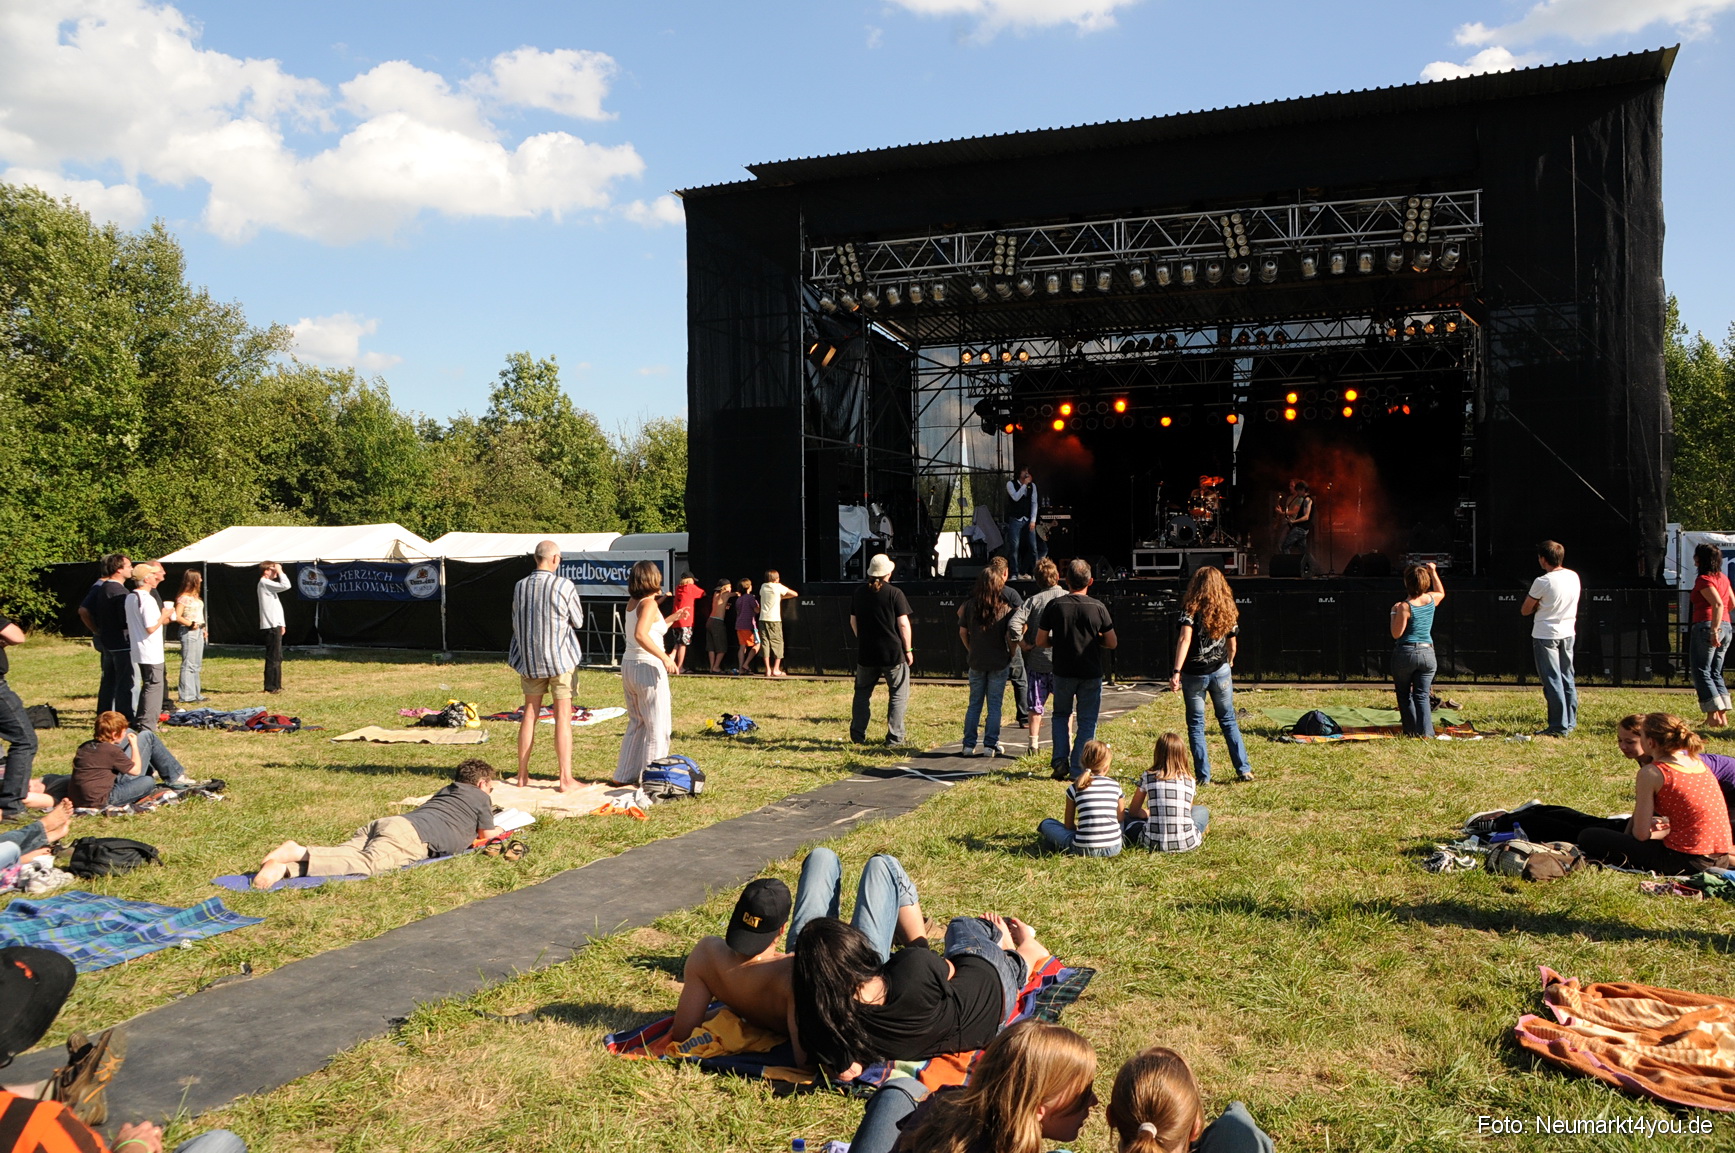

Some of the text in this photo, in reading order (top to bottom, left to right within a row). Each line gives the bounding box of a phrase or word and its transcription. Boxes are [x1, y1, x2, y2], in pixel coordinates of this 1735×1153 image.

[339, 569, 394, 581] HERZLICH
[328, 581, 405, 593] WILLKOMMEN
[742, 911, 763, 929] CAT
